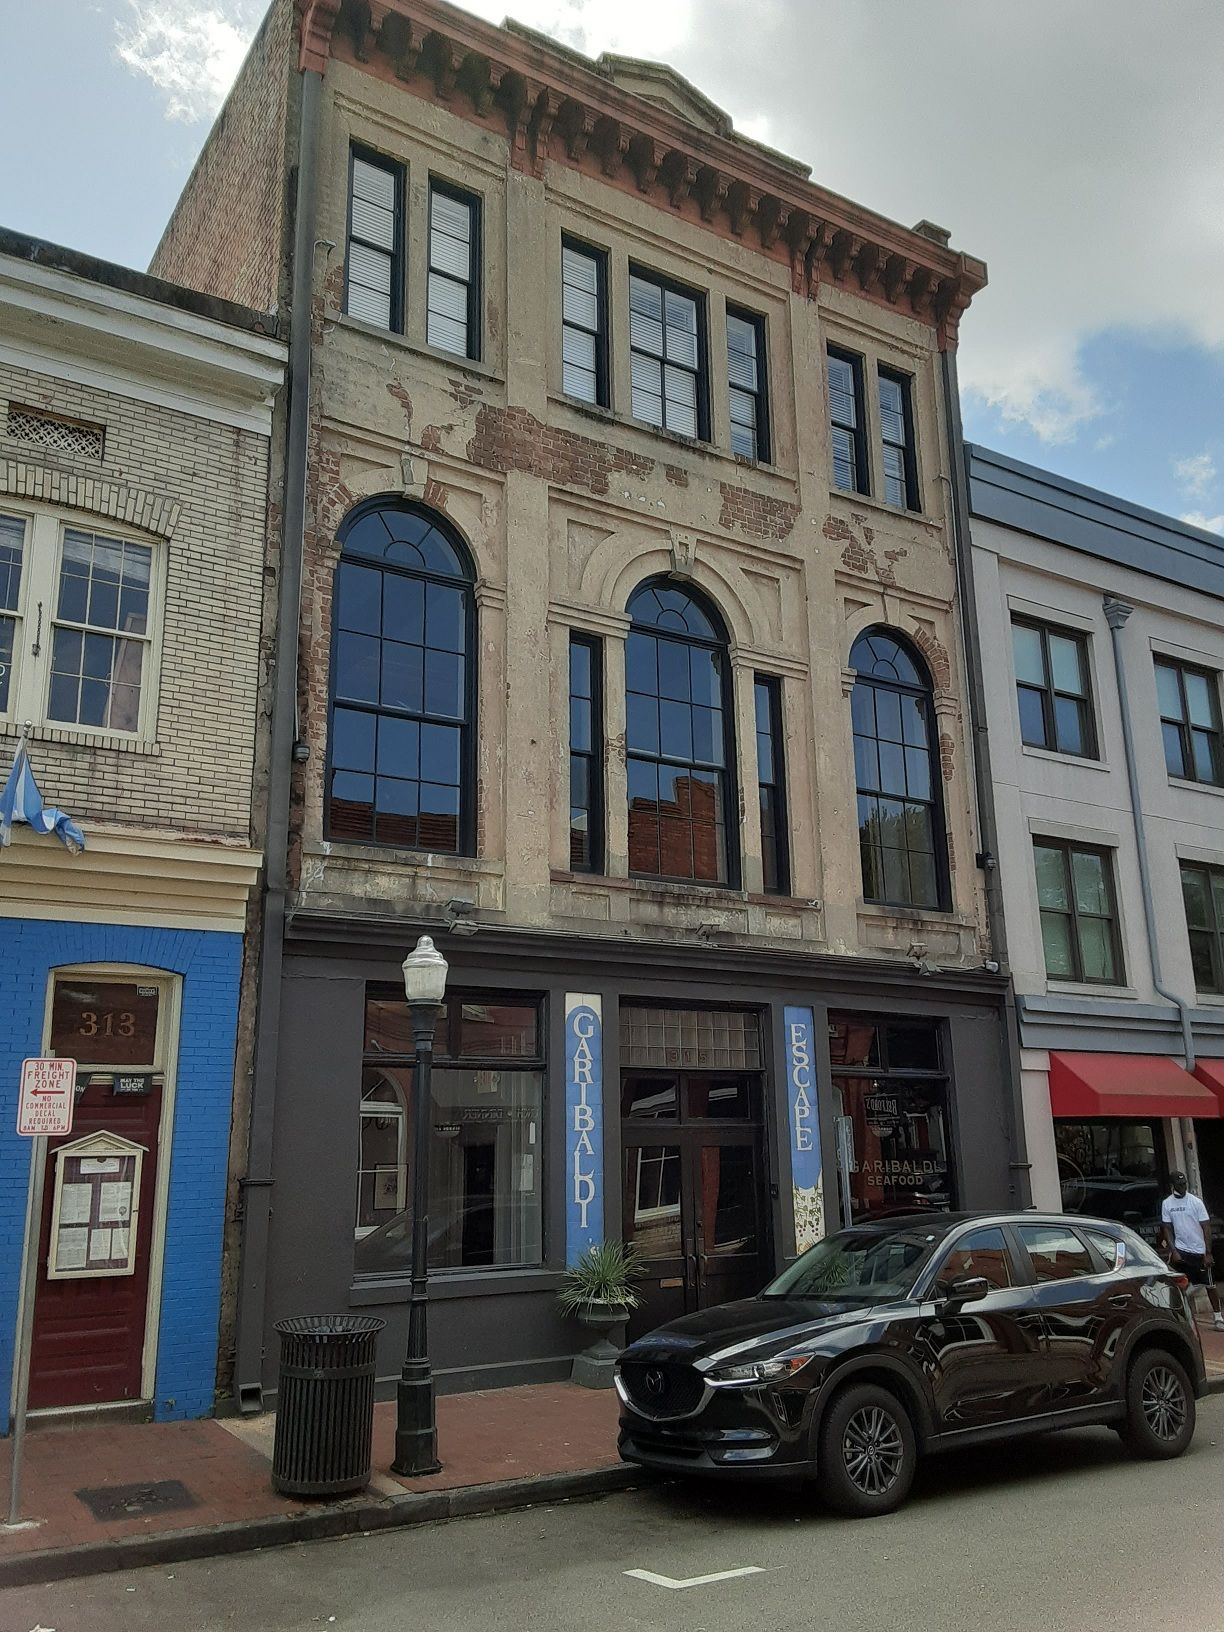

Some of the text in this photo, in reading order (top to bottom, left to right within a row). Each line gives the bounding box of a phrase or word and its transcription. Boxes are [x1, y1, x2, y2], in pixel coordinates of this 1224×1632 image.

[79, 1011, 136, 1037] 313
[34, 1062, 45, 1071] 30
[27, 1070, 70, 1080] FREIGHT
[34, 1080, 62, 1089] ZONE
[790, 1023, 814, 1151] ESCAPE
[25, 1102, 67, 1110] COMMERCIAL
[34, 1109, 56, 1117] DECAL
[28, 1117, 62, 1125] REQUIRED
[573, 1012, 595, 1228] GARIBALDI
[867, 1175, 924, 1186] SEAFOOD
